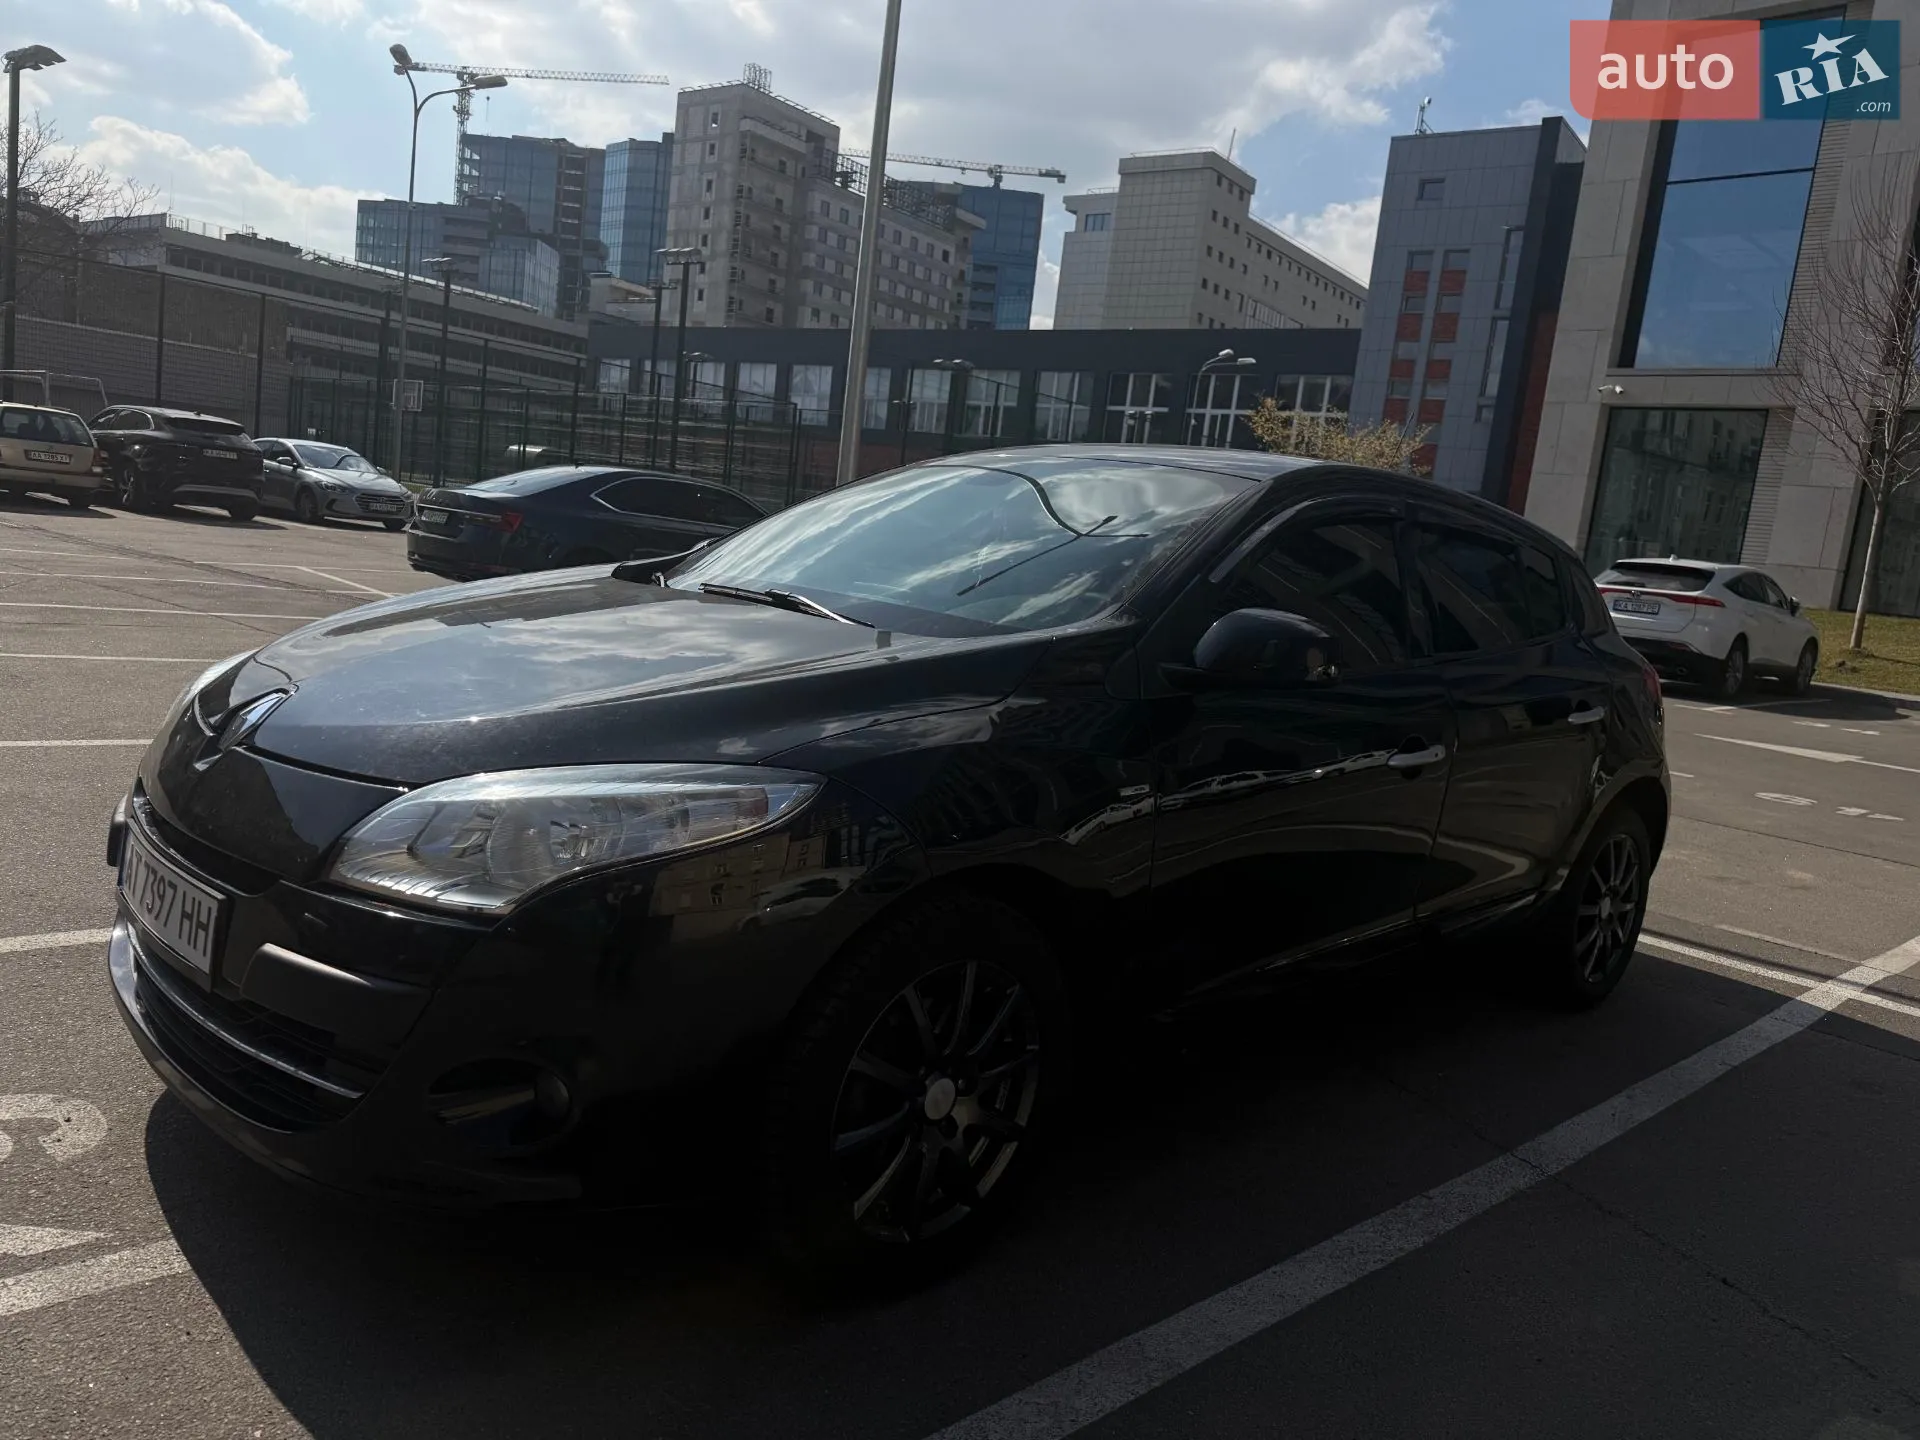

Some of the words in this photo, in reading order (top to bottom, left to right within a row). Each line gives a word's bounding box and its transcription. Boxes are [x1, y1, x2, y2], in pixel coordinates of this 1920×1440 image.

[125, 843, 142, 899] AT
[139, 859, 178, 928] 7397
[178, 890, 212, 957] HH
